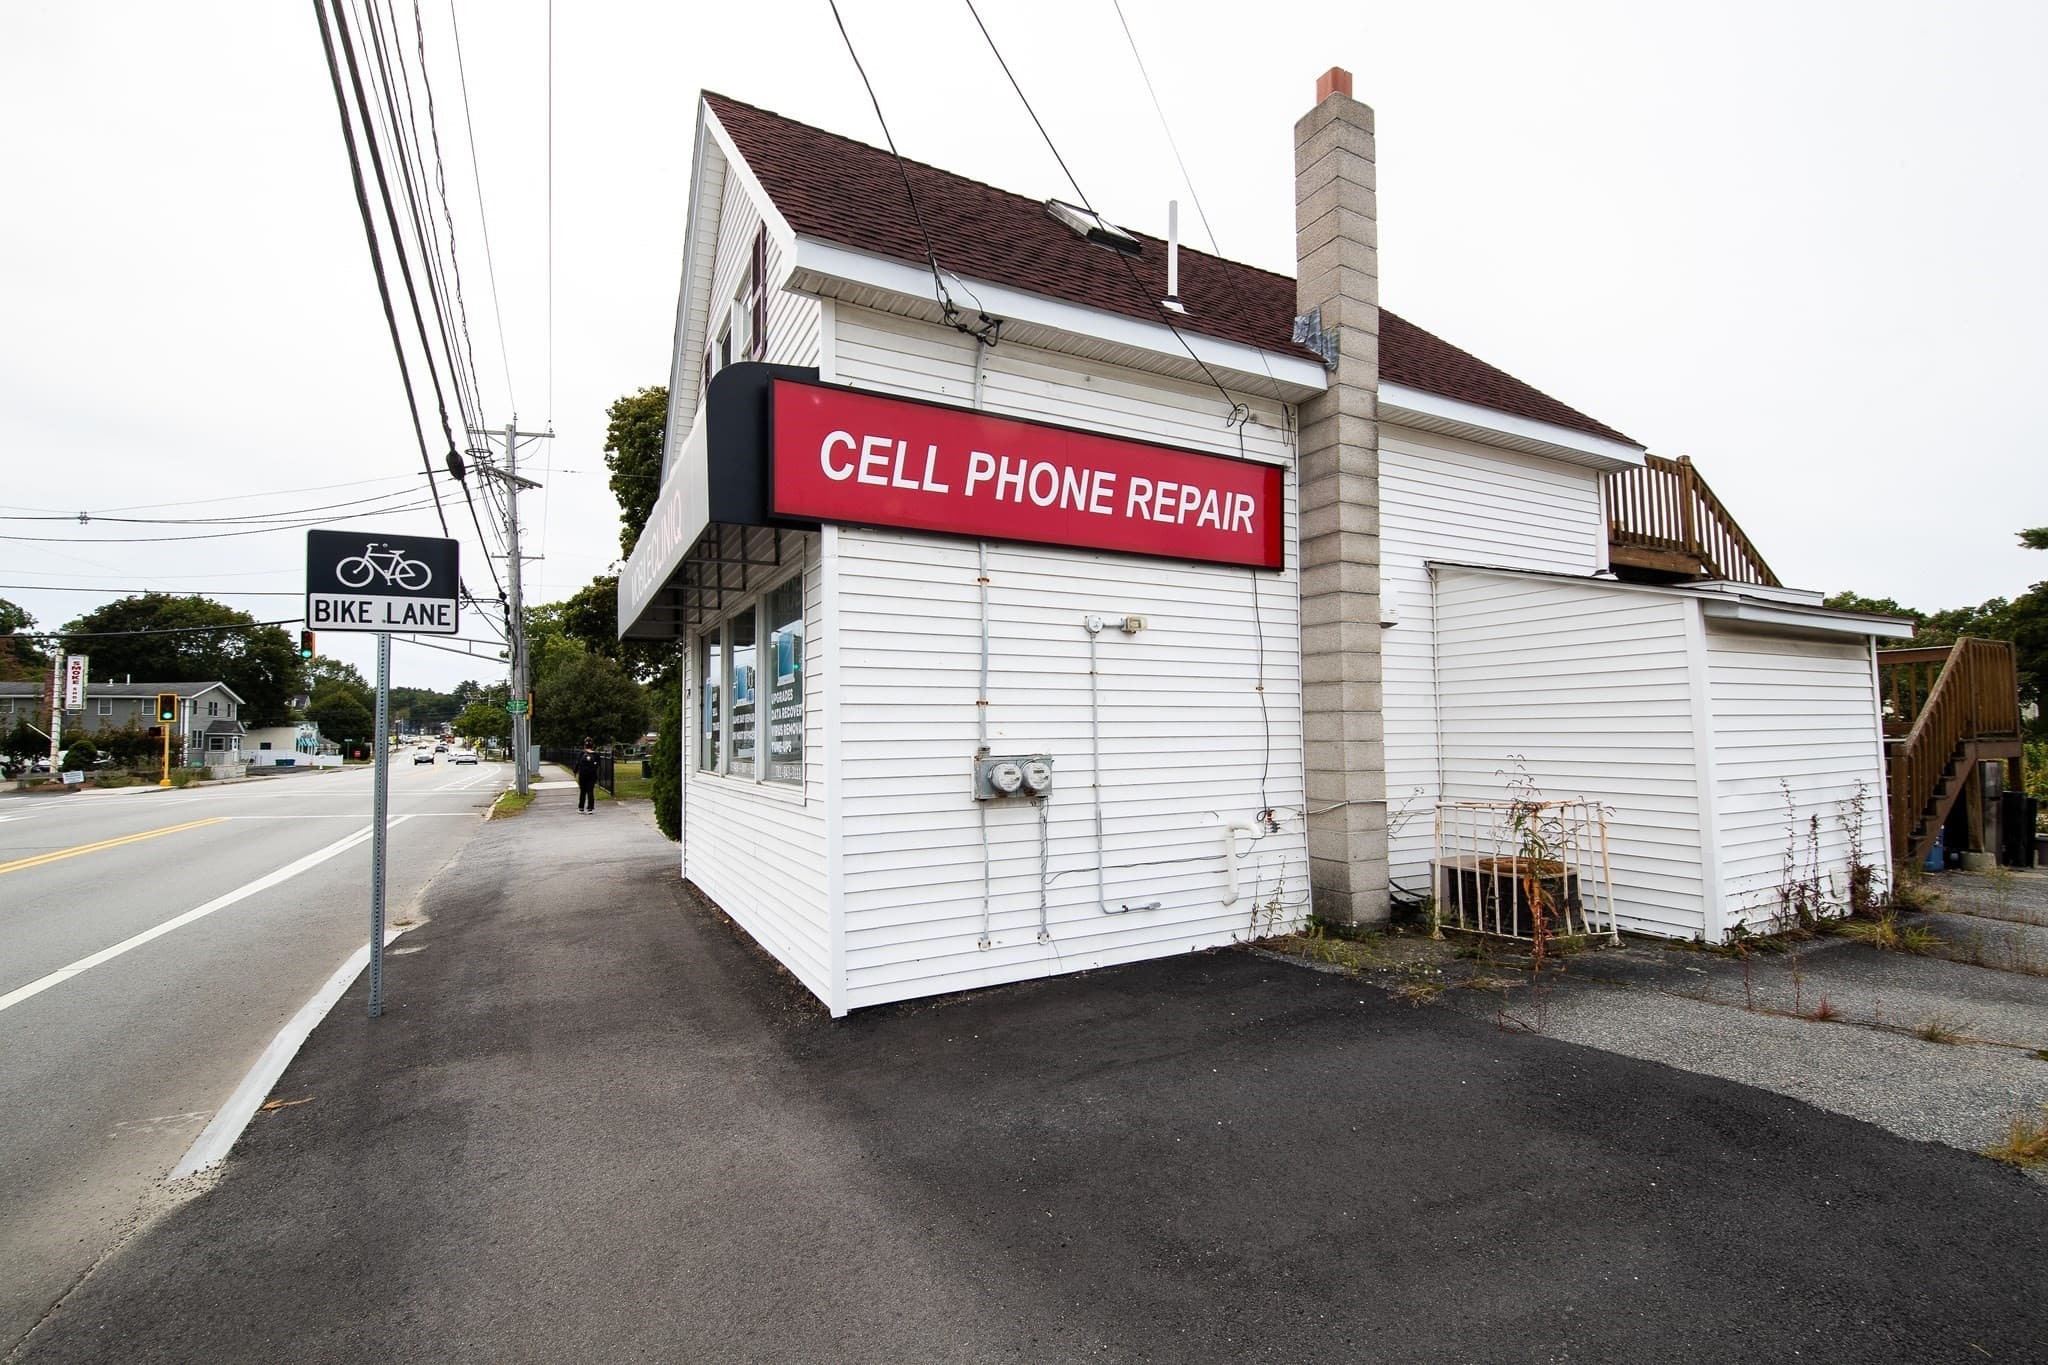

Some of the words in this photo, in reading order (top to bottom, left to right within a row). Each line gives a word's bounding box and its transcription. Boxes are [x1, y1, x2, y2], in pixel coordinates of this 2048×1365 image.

[820, 430, 949, 494] CELL
[965, 451, 1117, 515] PHONE
[1126, 477, 1256, 534] REPAIR
[315, 600, 373, 624] BIKE
[387, 602, 451, 626] LANE
[71, 661, 81, 685] SMOKE
[782, 703, 803, 719] RECOVER
[783, 722, 802, 736] REMOVA
